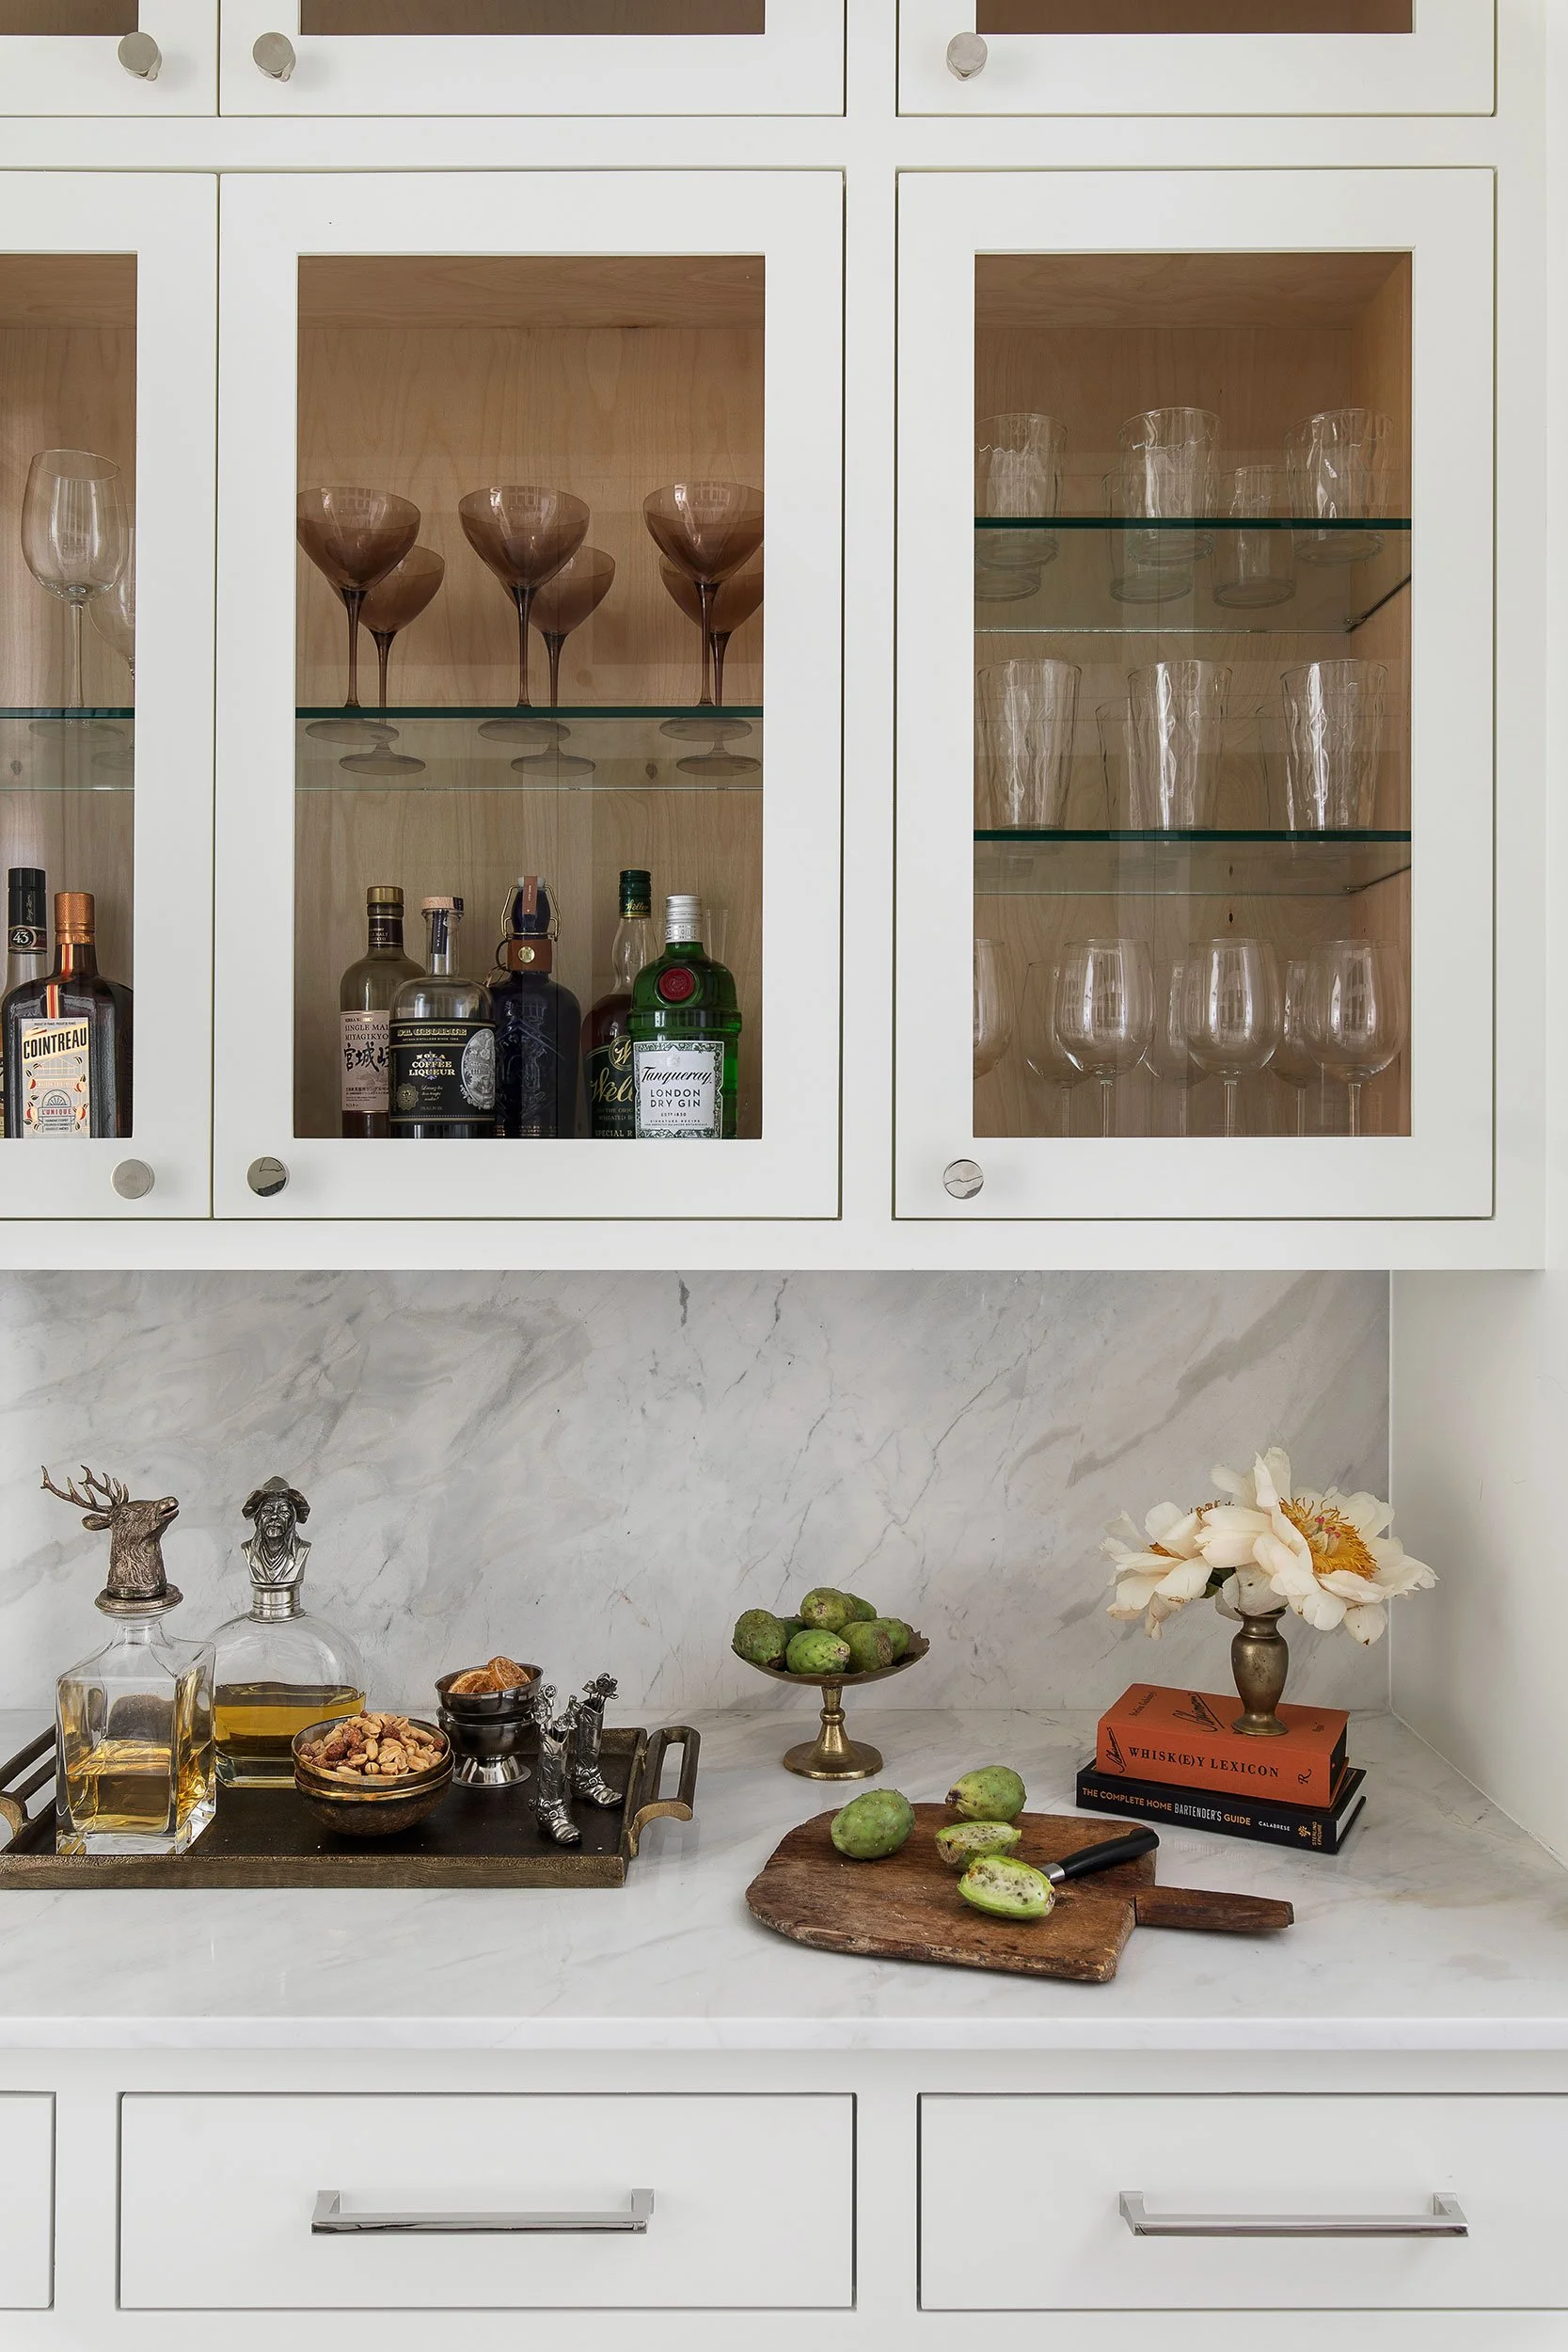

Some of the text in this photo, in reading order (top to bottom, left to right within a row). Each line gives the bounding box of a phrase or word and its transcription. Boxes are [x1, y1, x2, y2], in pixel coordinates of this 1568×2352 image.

[12, 931, 29, 944] 43
[24, 1027, 87, 1059] COINTREAU
[408, 1069, 456, 1077] LIQUEUR
[650, 1089, 701, 1098] LONDON
[650, 1099, 701, 1107] DRY GIN
[1129, 1746, 1279, 1777] WHISK(E)Y LEXICON
[1298, 1769, 1312, 1785] R
[1083, 1788, 1251, 1826] THE COMPLETE HOME BARTENDER'S GUIDE
[1259, 1820, 1291, 1832] CALABRESE
